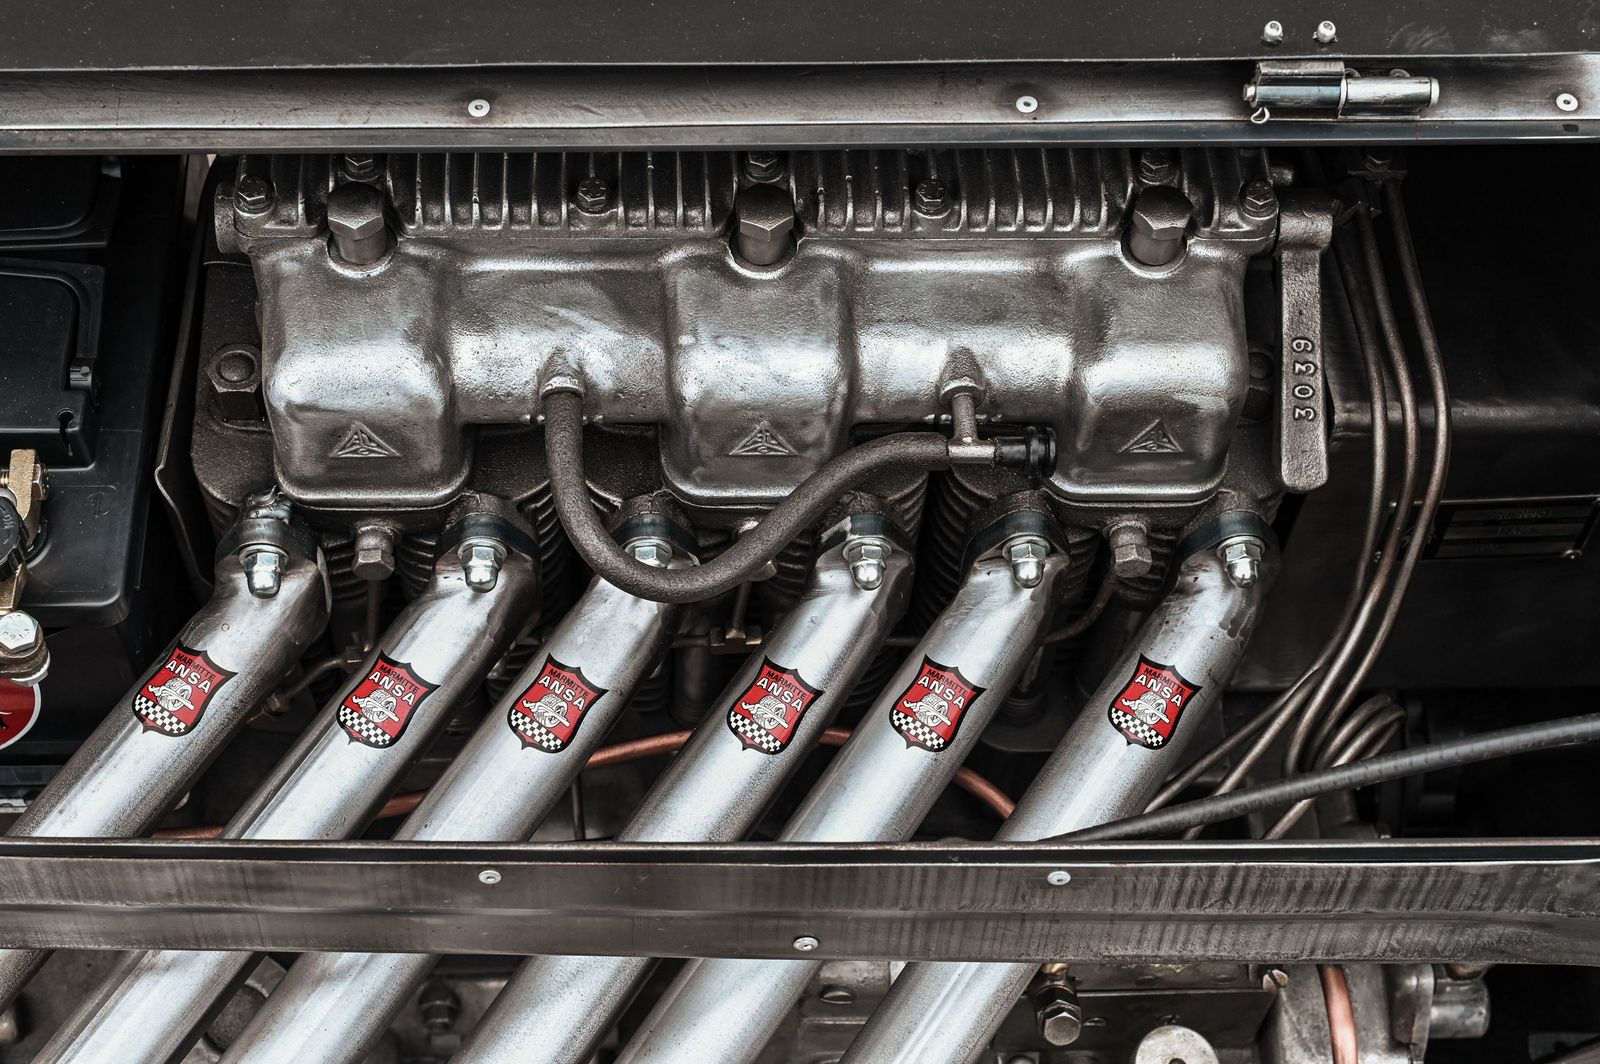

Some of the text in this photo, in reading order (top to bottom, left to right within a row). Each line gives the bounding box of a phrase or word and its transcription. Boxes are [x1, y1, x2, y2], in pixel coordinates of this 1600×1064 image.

[165, 660, 211, 694] ANSA
[175, 652, 216, 682] MARMITTE
[378, 664, 420, 694] MARMITTE
[1143, 667, 1186, 696] MARMITTE
[369, 671, 415, 706] ANSA
[538, 675, 585, 711] ANSA
[548, 668, 589, 698] MARMITTE
[756, 677, 803, 712] ANSA
[766, 670, 807, 700] MARMITTE
[917, 675, 965, 710] ANSA
[926, 669, 969, 698] MARMITTE
[1134, 674, 1182, 707] ANSA
